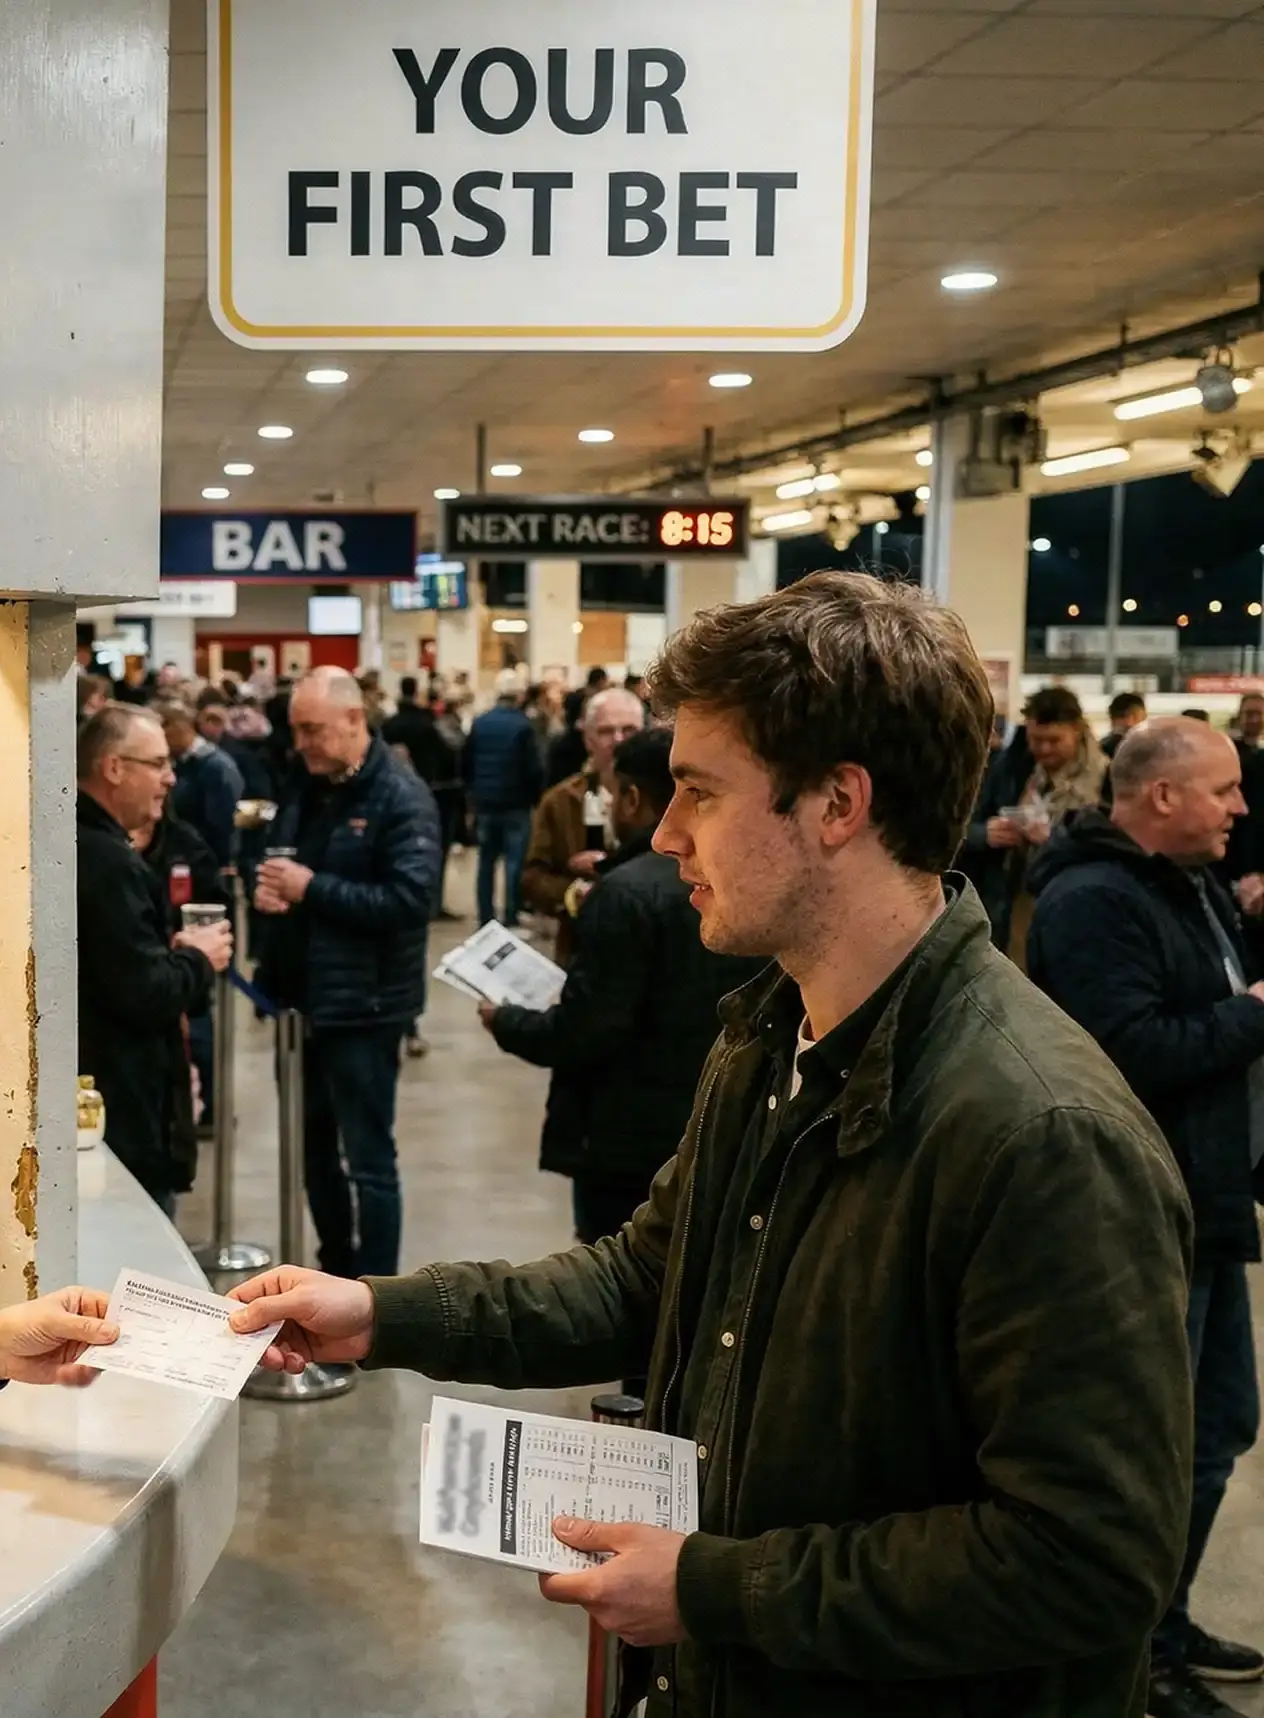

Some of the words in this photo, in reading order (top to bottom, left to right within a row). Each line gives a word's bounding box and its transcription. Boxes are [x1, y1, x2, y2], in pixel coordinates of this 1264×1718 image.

[392, 46, 688, 136] YOUR
[288, 170, 574, 258] FIRST
[607, 171, 798, 257] BET
[211, 520, 347, 571] BAR
[456, 513, 546, 543] NEXT
[552, 513, 650, 543] RACE:
[660, 511, 734, 546] 8:15
